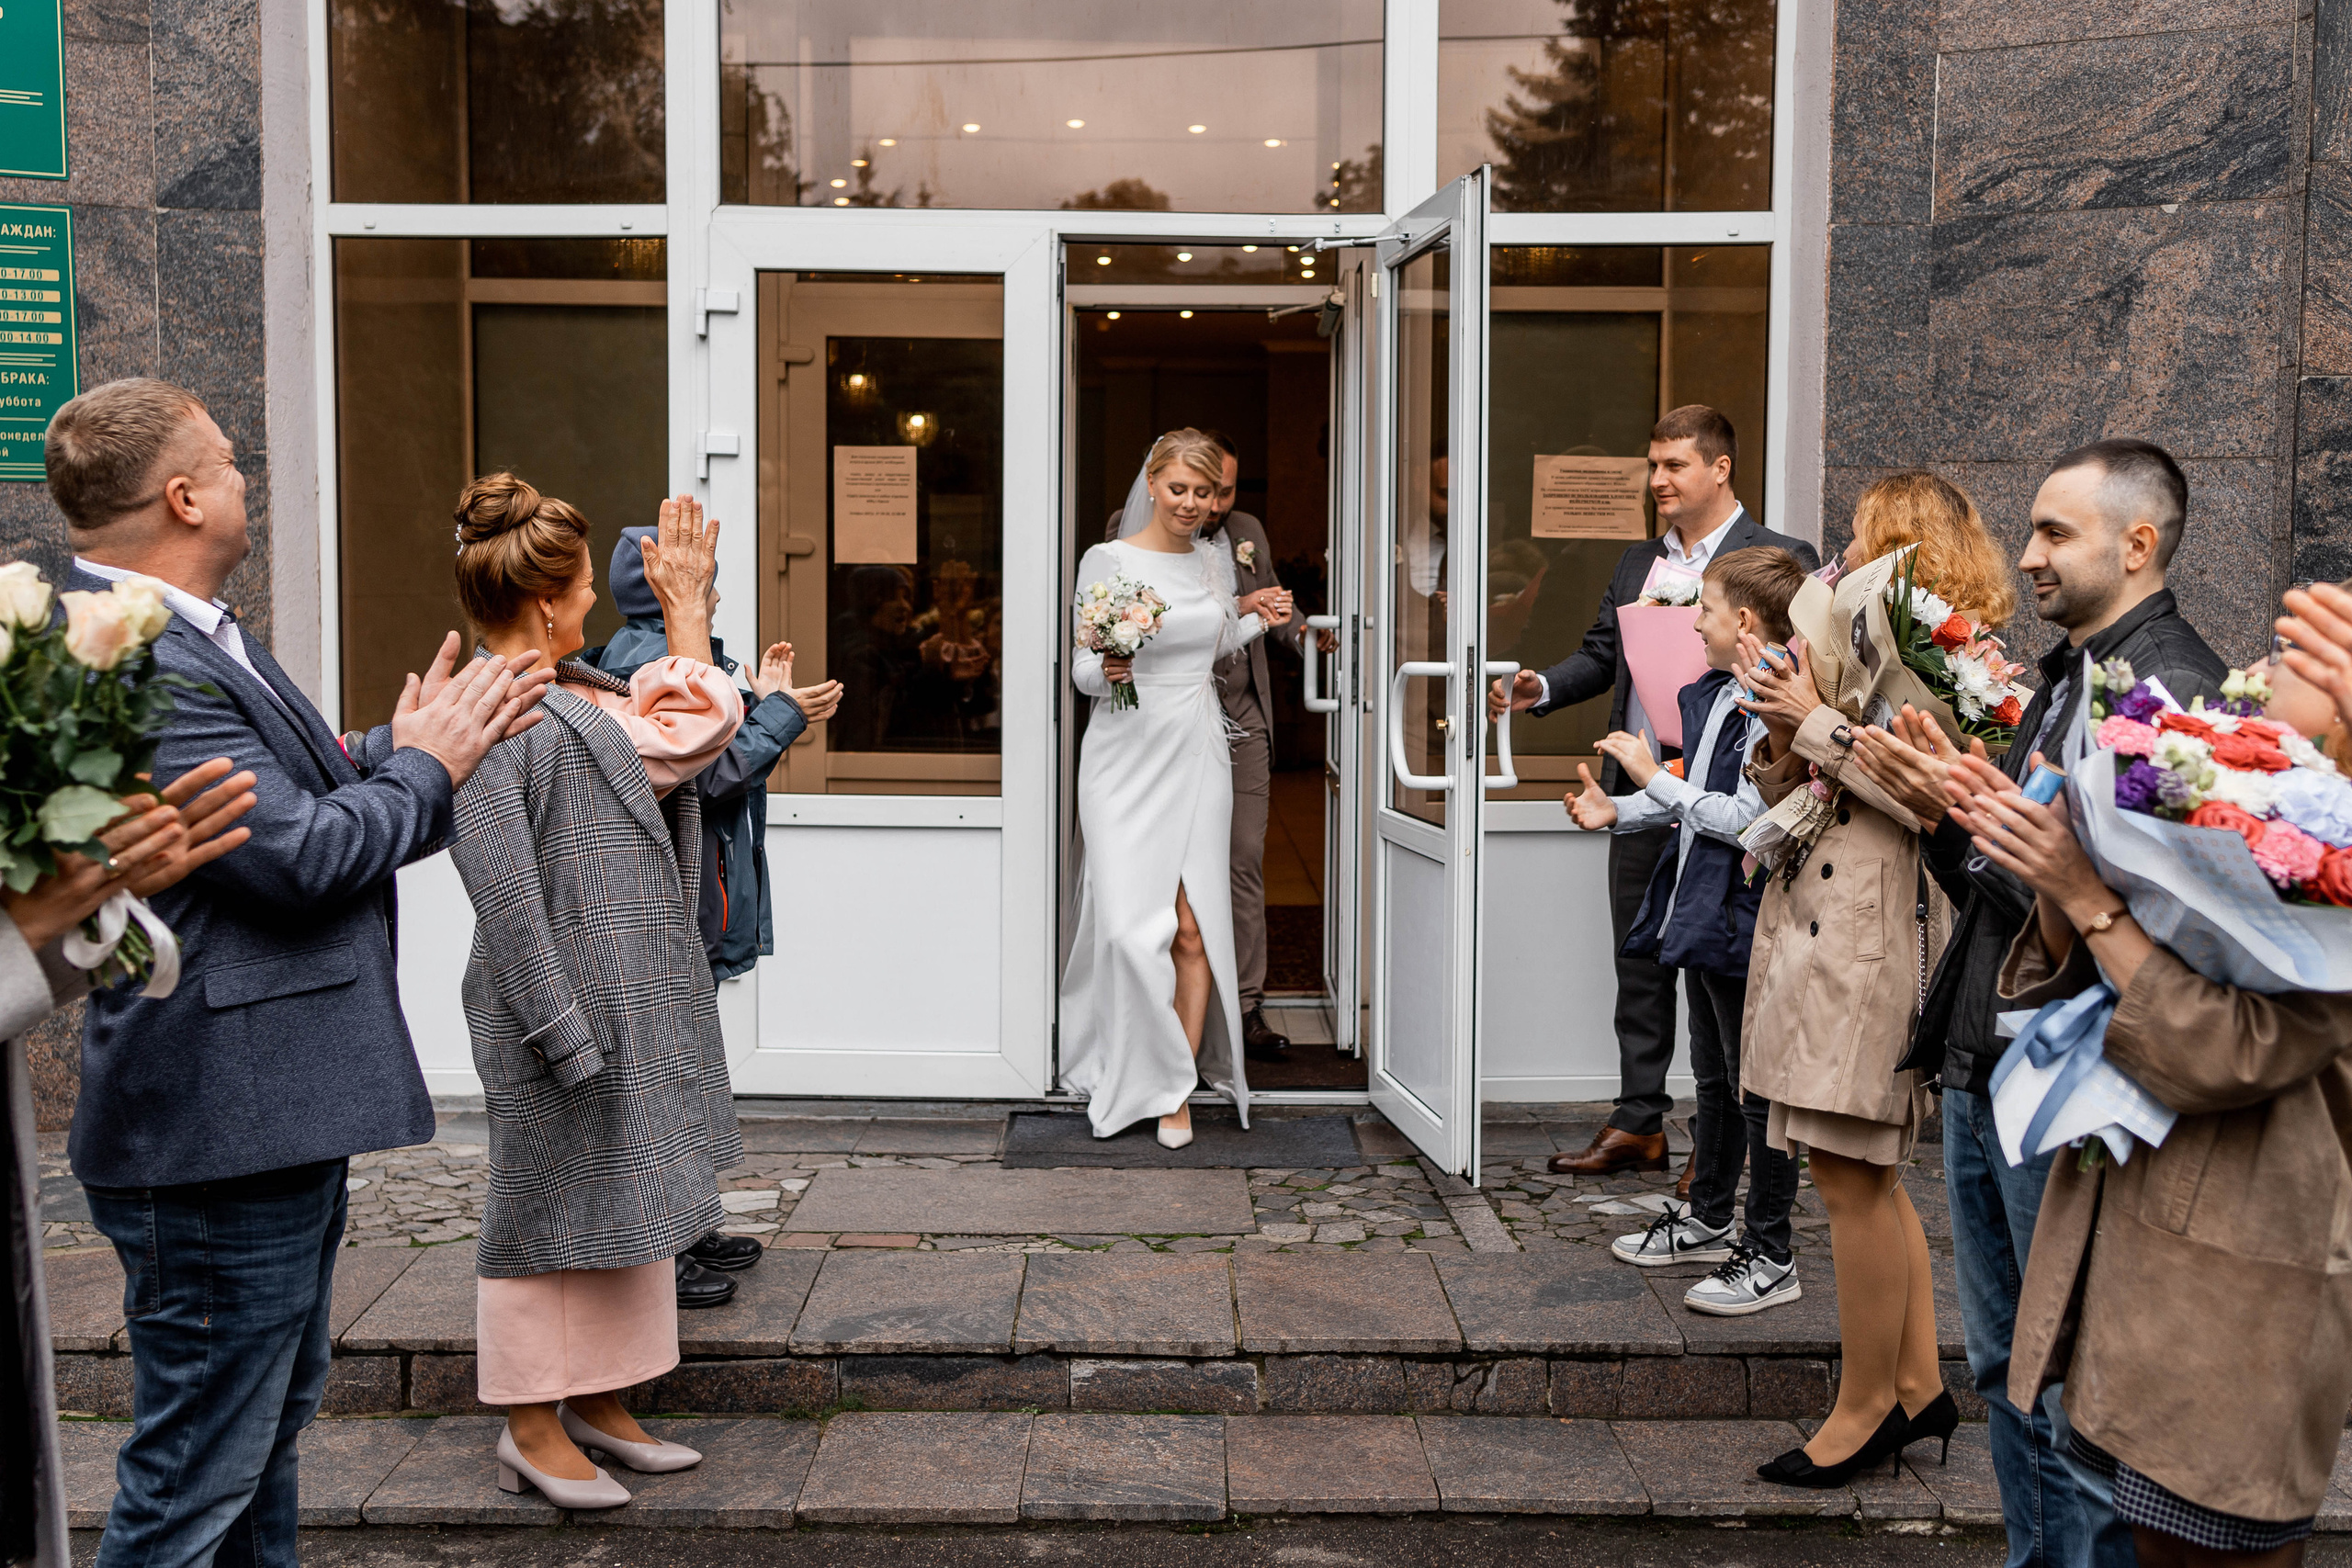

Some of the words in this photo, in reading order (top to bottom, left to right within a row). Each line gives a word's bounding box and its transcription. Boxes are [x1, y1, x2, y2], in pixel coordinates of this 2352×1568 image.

[1, 223, 56, 239] АЖДАН:
[0, 310, 44, 322] 0-17.00
[1, 371, 50, 385] БРАКА:
